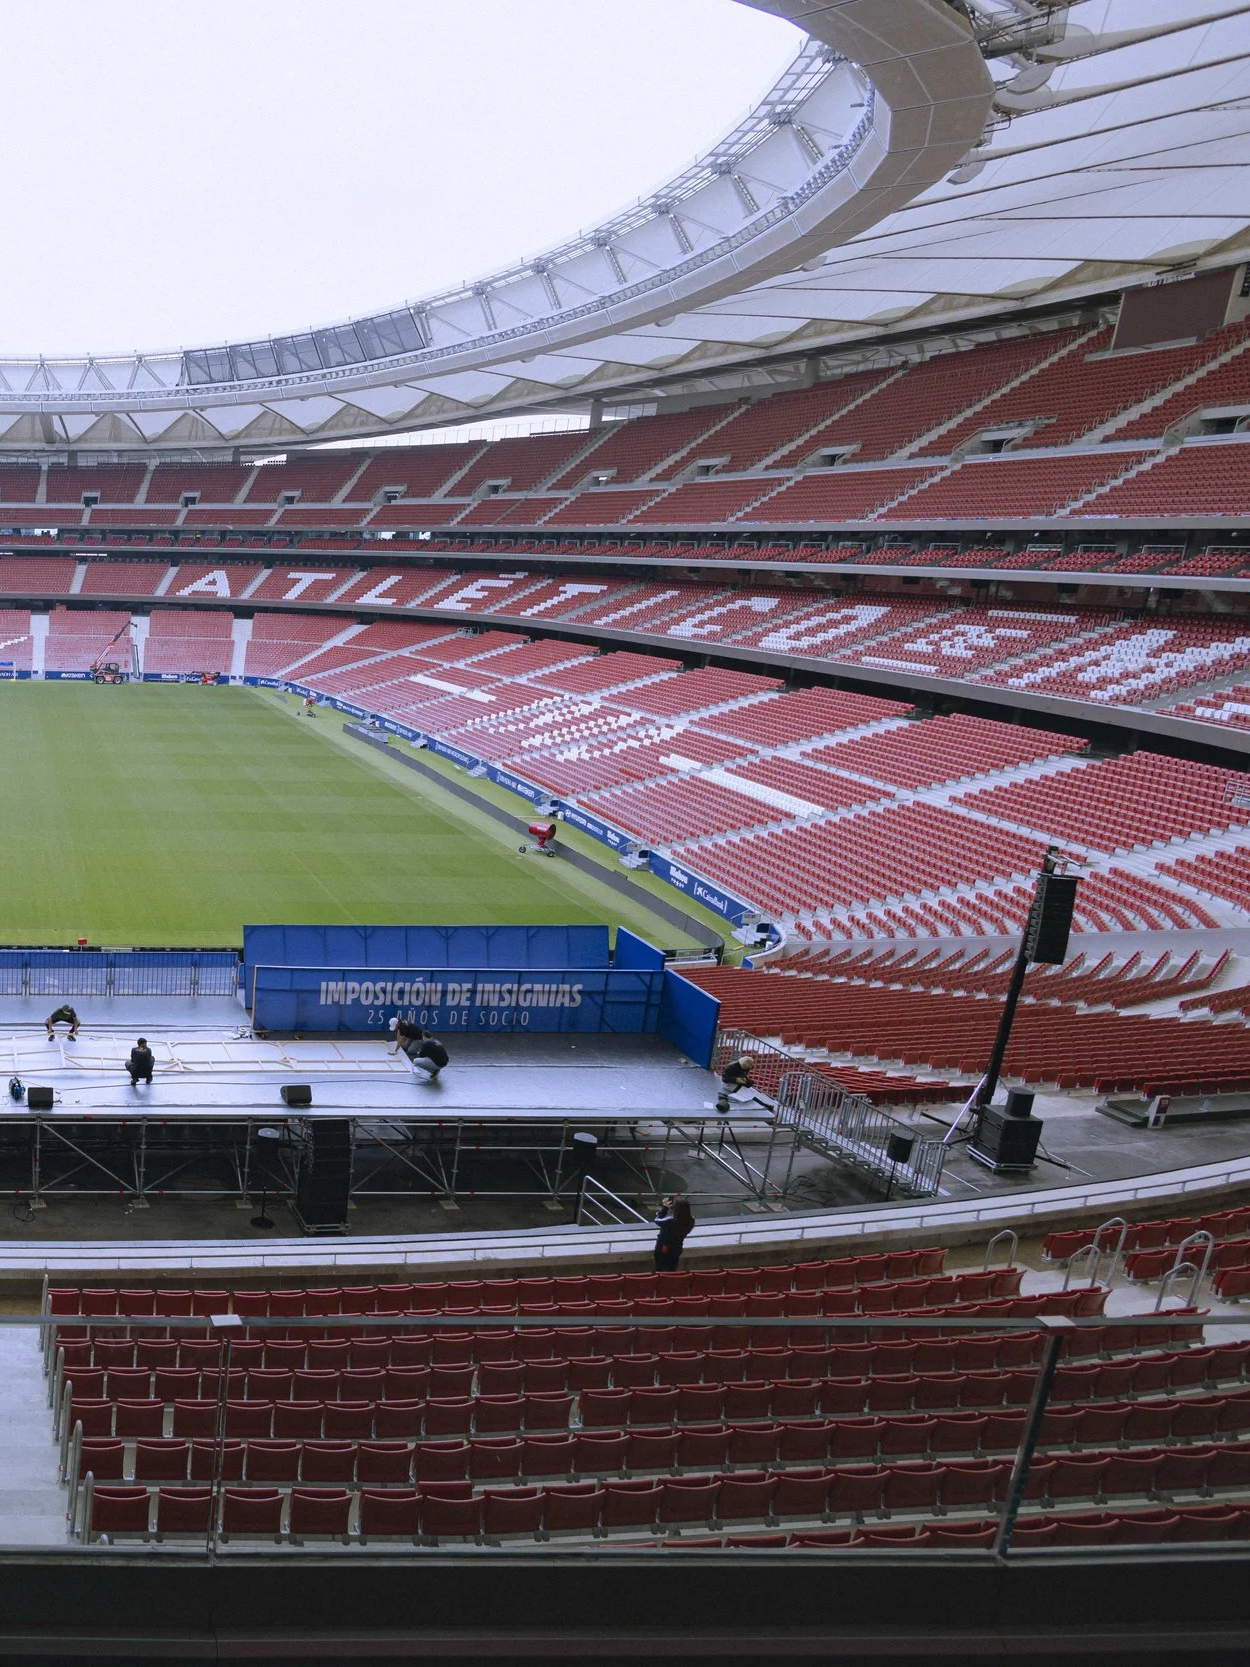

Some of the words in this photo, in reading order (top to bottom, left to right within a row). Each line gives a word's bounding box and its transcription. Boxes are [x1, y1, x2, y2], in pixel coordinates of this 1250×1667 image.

[670, 865, 688, 884] Mahou
[319, 977, 442, 1006] IMPOSICIÓN
[446, 983, 473, 1007] DE
[475, 983, 583, 1008] INSIGNIAS
[367, 1010, 384, 1024] 25
[396, 1007, 439, 1025] AÑOS
[449, 1010, 469, 1025] DE
[478, 1011, 529, 1026] SOCIO
